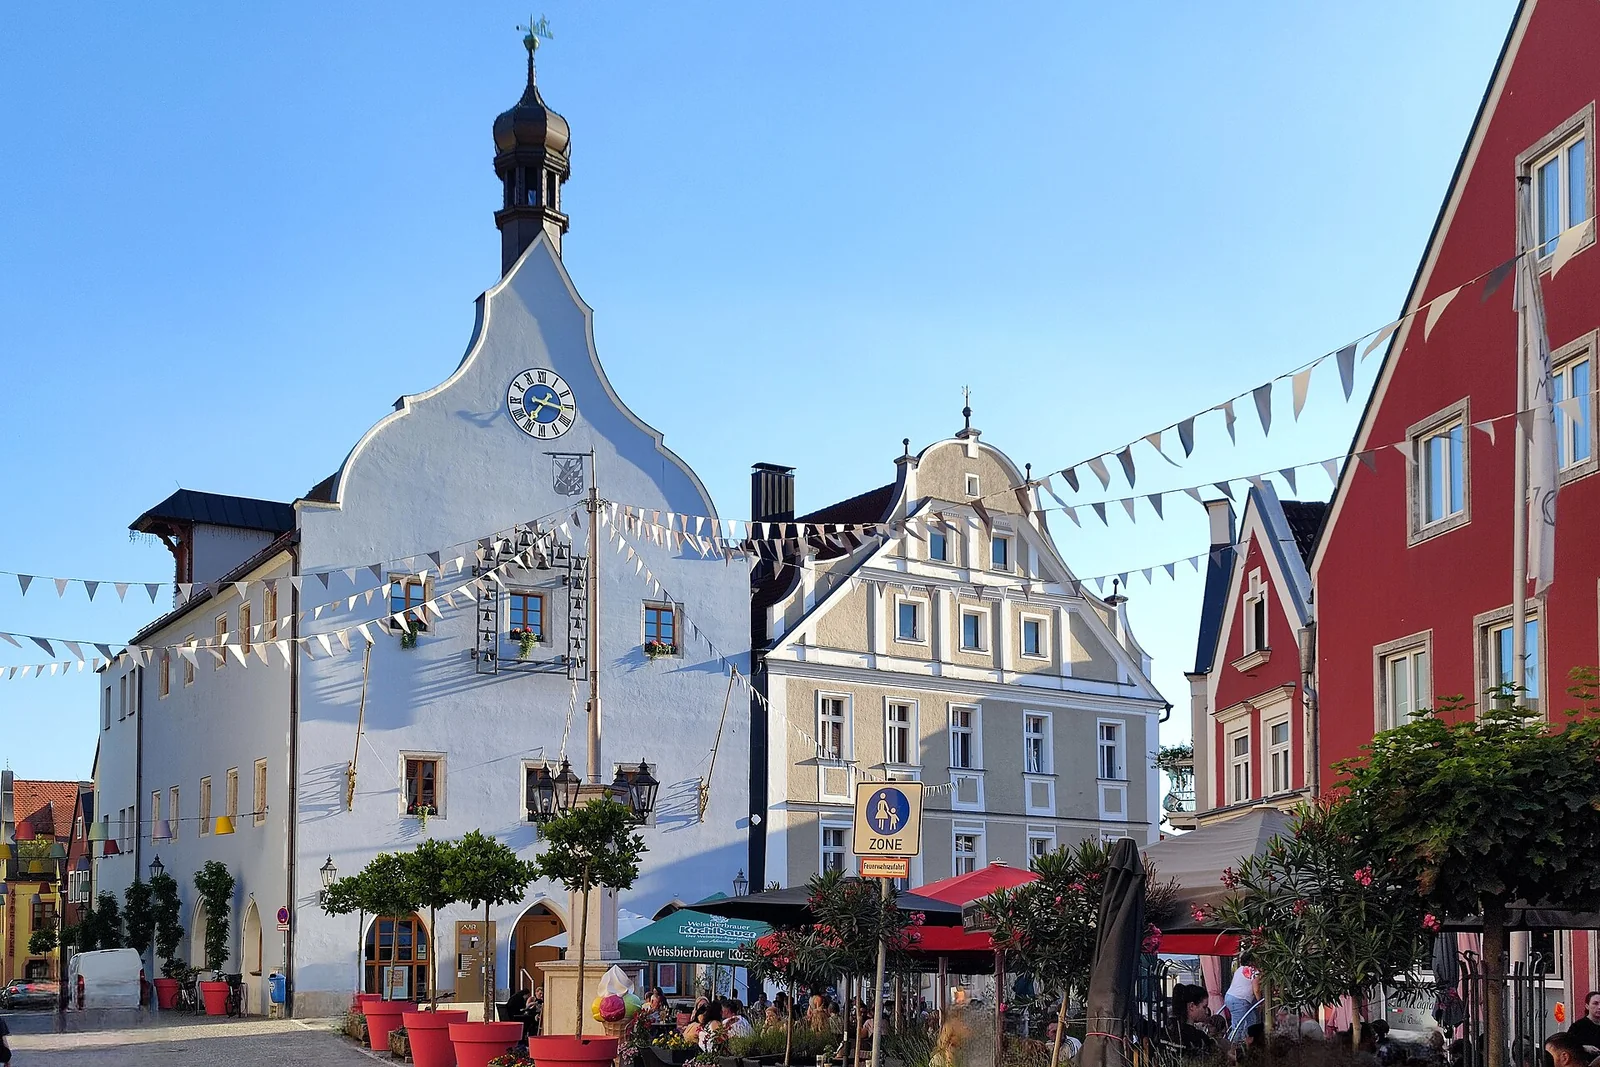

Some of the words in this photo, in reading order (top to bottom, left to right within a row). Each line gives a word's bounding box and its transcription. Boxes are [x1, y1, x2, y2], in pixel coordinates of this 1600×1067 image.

[869, 838, 902, 850] ZONE
[688, 921, 750, 930] Weissbierbrauer
[646, 945, 725, 960] Weissbierbrauer
